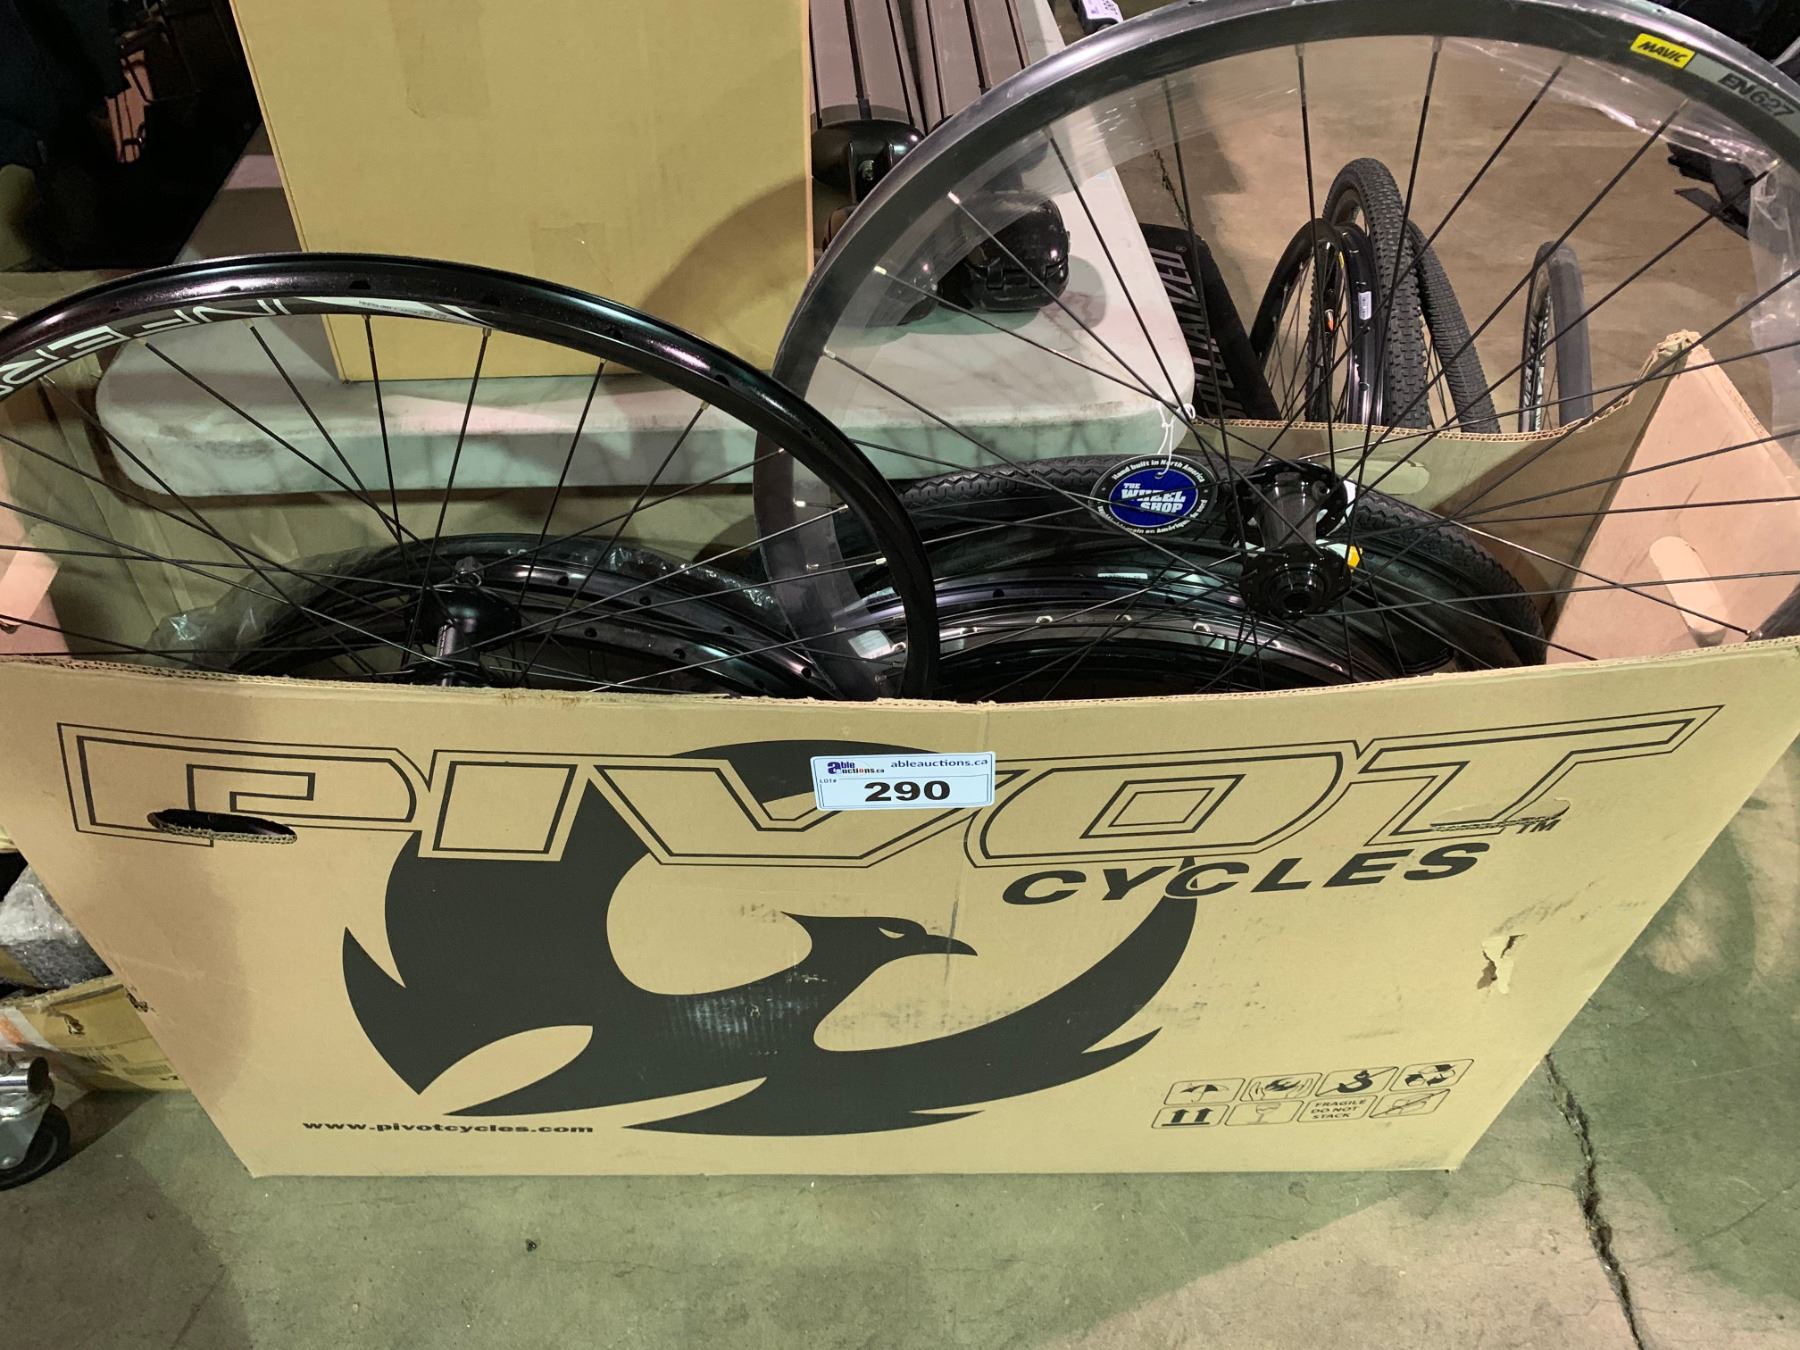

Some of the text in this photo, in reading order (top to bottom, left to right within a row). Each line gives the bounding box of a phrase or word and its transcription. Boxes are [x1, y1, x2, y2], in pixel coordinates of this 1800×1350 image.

[1638, 41, 1688, 63] MAVIC
[1111, 466, 1131, 480] Hand
[1130, 460, 1150, 470] built
[1182, 464, 1205, 483] America
[1121, 489, 1187, 503] WHEEL
[1140, 502, 1184, 513] SHOP
[890, 759, 988, 768] ableauctions.ca
[55, 705, 1724, 868] PIVOT
[864, 780, 950, 802] 290
[1001, 842, 1490, 905] CYCLES
[1315, 1099, 1366, 1107] FRAGILE
[1333, 1105, 1358, 1113] NOT
[302, 1122, 594, 1134] www.pivotcycles.com
